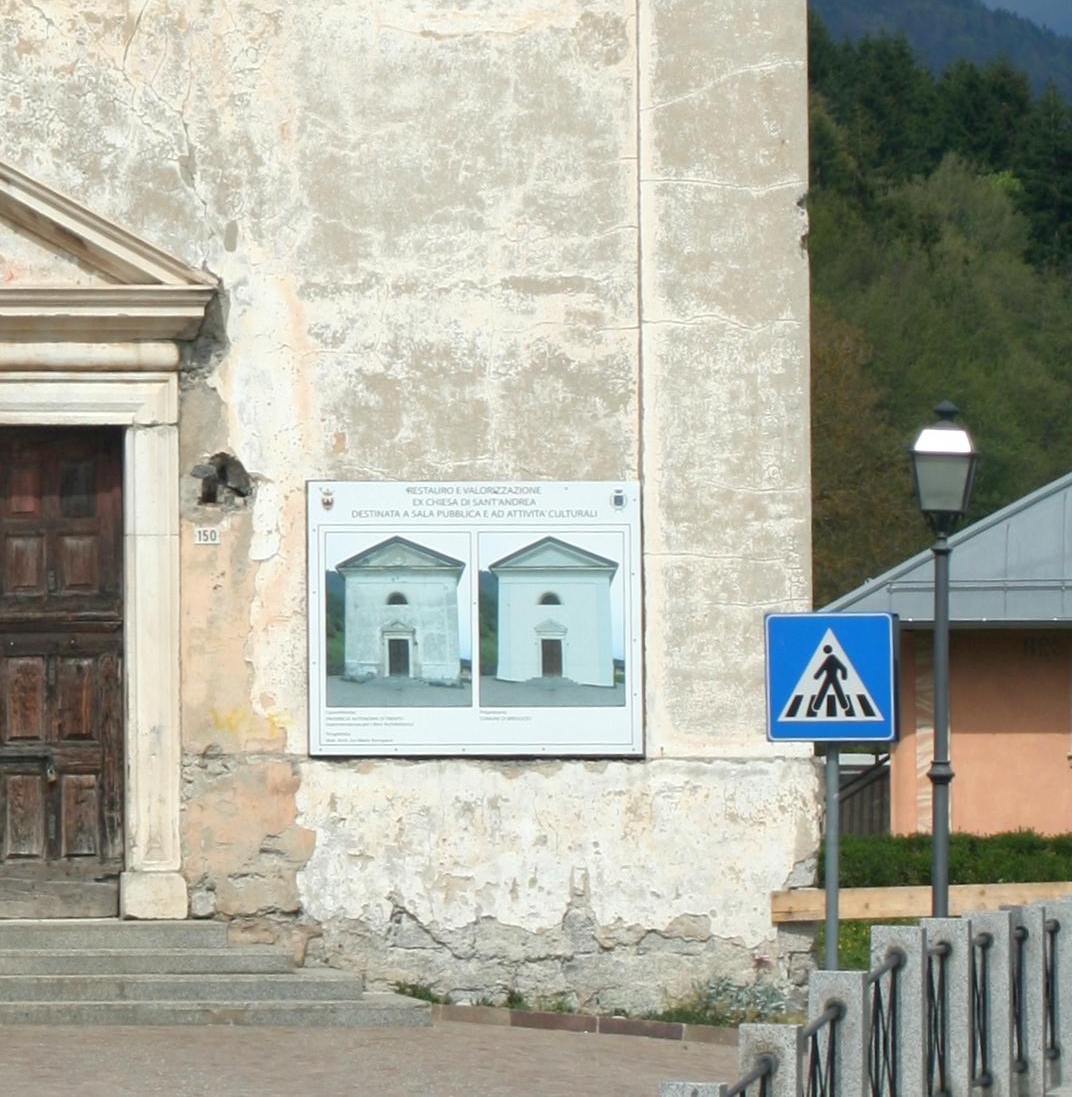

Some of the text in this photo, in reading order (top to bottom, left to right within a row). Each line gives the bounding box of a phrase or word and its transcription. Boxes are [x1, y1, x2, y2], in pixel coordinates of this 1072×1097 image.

[407, 486, 542, 495] RESTAURO E VALORIZZAZIONE
[412, 497, 536, 506] EX CHIESA DI SANT'ANDREA
[351, 509, 400, 518] DESTINATA
[402, 509, 409, 518] A
[411, 509, 434, 518] SALA
[437, 509, 481, 518] PUBBLICA
[483, 509, 489, 518] E
[491, 509, 504, 518] AD
[548, 509, 598, 518] CULTURALI
[197, 529, 217, 542] 150
